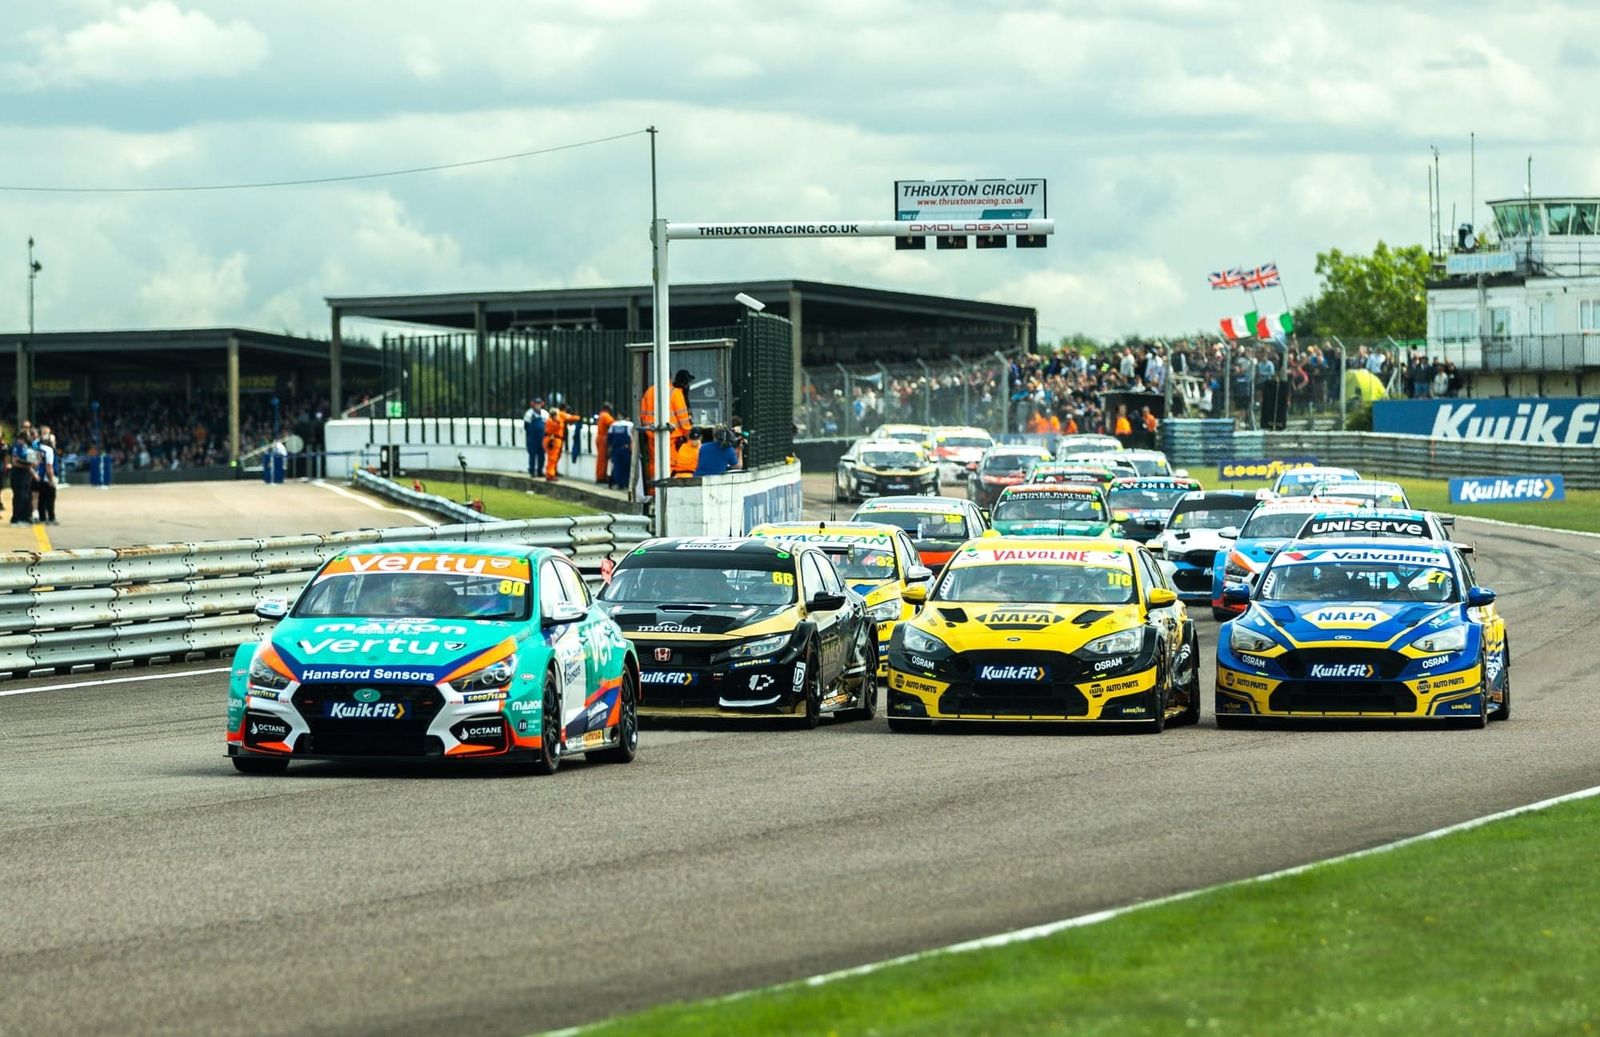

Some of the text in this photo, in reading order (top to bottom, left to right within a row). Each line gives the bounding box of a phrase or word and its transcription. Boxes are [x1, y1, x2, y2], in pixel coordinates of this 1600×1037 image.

[903, 183, 1038, 197] THRUXTON CIRCUIT
[917, 197, 1024, 206] www.thruxtonracing.co.uk
[698, 224, 859, 236] THRUXTONRACING.CO.UK
[909, 223, 1029, 232] OMOLOGATO
[993, 549, 1090, 562] VALVOLINE
[1332, 551, 1440, 564] Valvoline
[1107, 572, 1133, 587] 116
[498, 580, 526, 596] 80
[990, 613, 1050, 623] NAPA
[1317, 611, 1377, 621] NAPA
[637, 623, 702, 634] metclad
[301, 638, 440, 655] vertu
[911, 655, 935, 670] OSRAM
[1094, 657, 1123, 672] OSRAM
[1242, 654, 1266, 668] OSRAM
[1422, 654, 1449, 669] OSRAM
[302, 668, 435, 681] Hansford Sensors
[906, 680, 920, 690] AUTO
[919, 683, 937, 694] PARTS
[1106, 680, 1139, 693] AUTO PARTS
[258, 723, 286, 733] OCTANE
[469, 726, 502, 735] OCTANE
